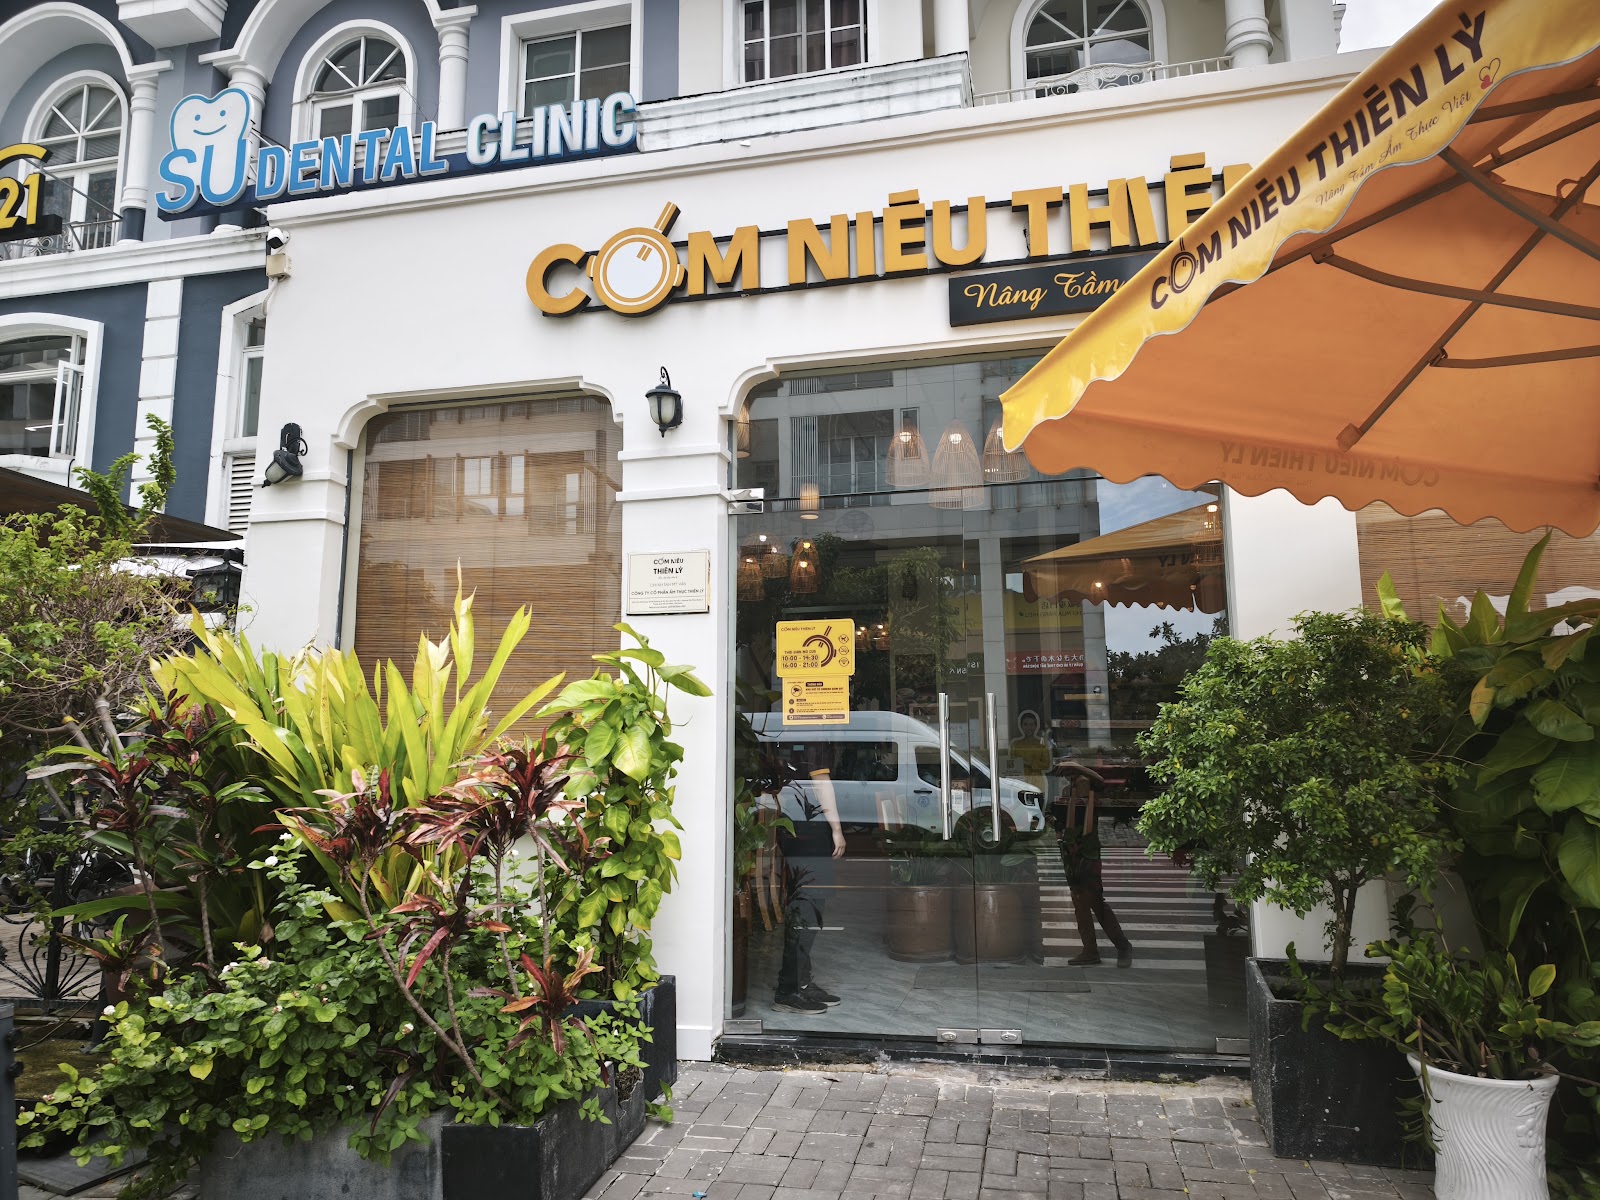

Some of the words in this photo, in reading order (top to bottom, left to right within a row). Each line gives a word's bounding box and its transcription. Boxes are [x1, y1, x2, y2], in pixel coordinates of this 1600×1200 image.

[156, 138, 248, 212] SU
[255, 120, 450, 199] DENTAL
[465, 91, 639, 168] CLINIC
[963, 280, 1048, 311] Nâng
[1053, 270, 1126, 299] Tầm
